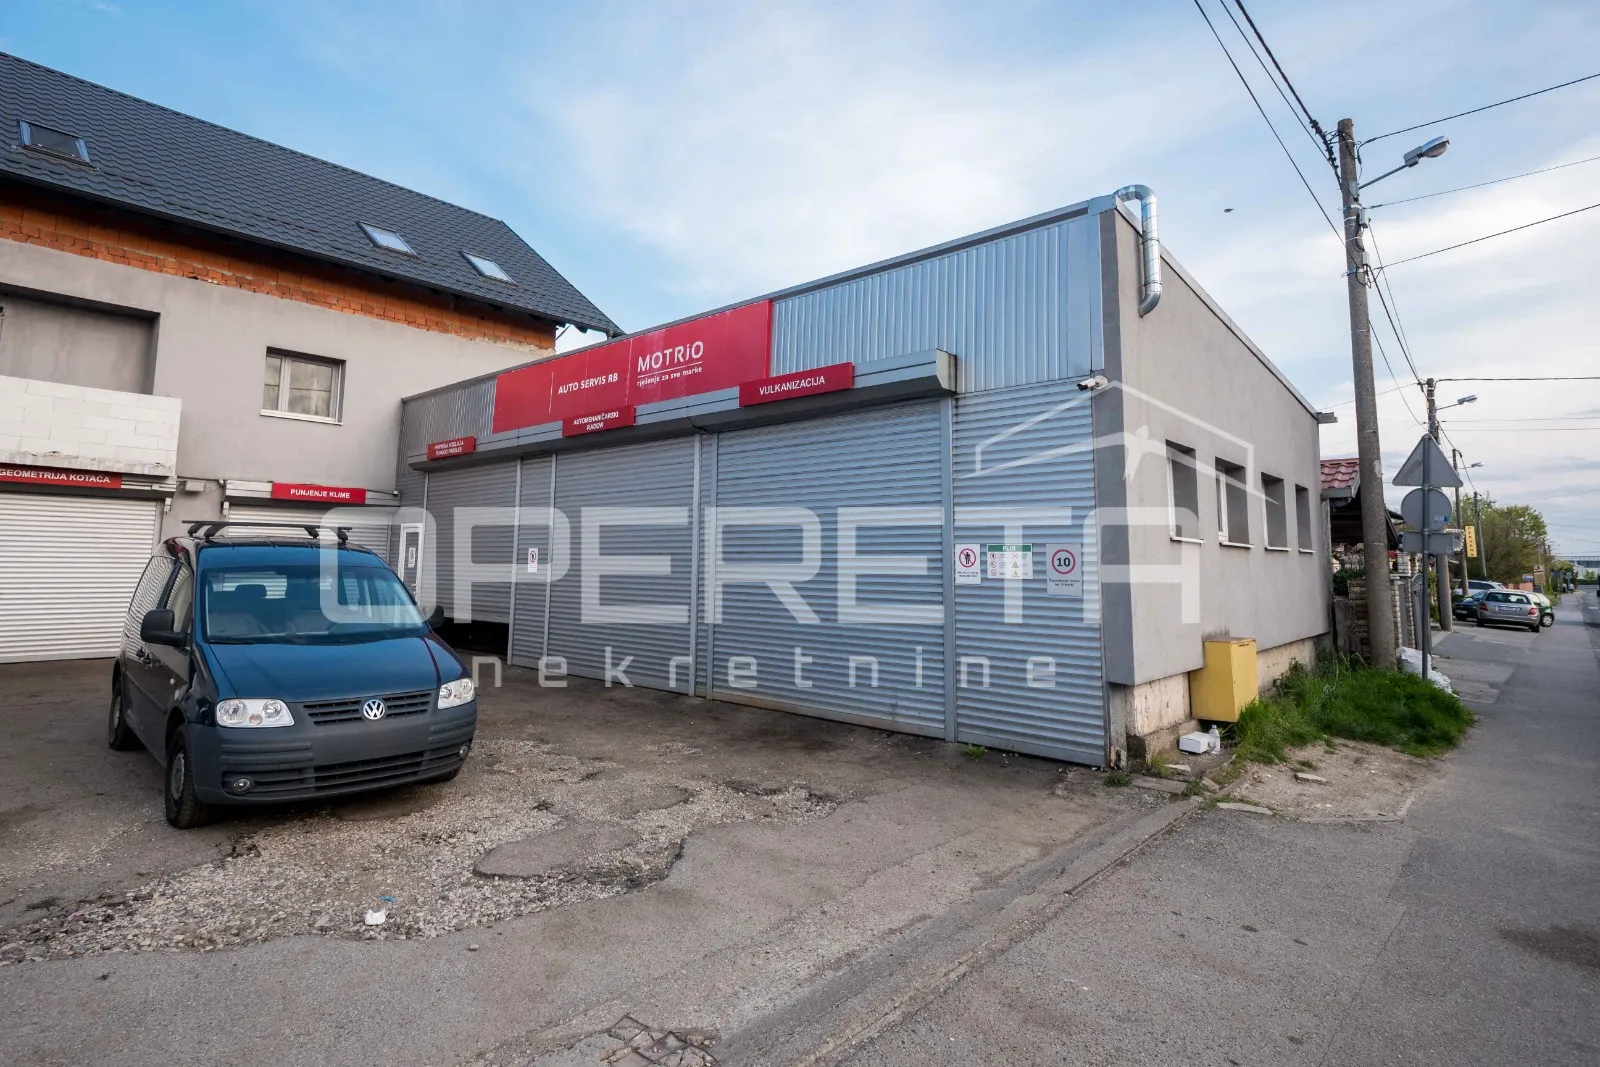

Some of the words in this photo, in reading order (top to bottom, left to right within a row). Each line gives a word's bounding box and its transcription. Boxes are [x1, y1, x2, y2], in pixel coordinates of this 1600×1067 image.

[670, 371, 681, 379] sve
[682, 366, 703, 376] marke
[557, 382, 579, 395] AUTO
[580, 375, 607, 389] SERVIS
[607, 372, 619, 383] RB
[759, 375, 826, 396] VULKANIZACIJA
[0, 468, 68, 481] GEOMETRIJA
[290, 488, 328, 498] PUNJENJE
[329, 490, 351, 499] KLIME
[1056, 557, 1071, 568] 10
